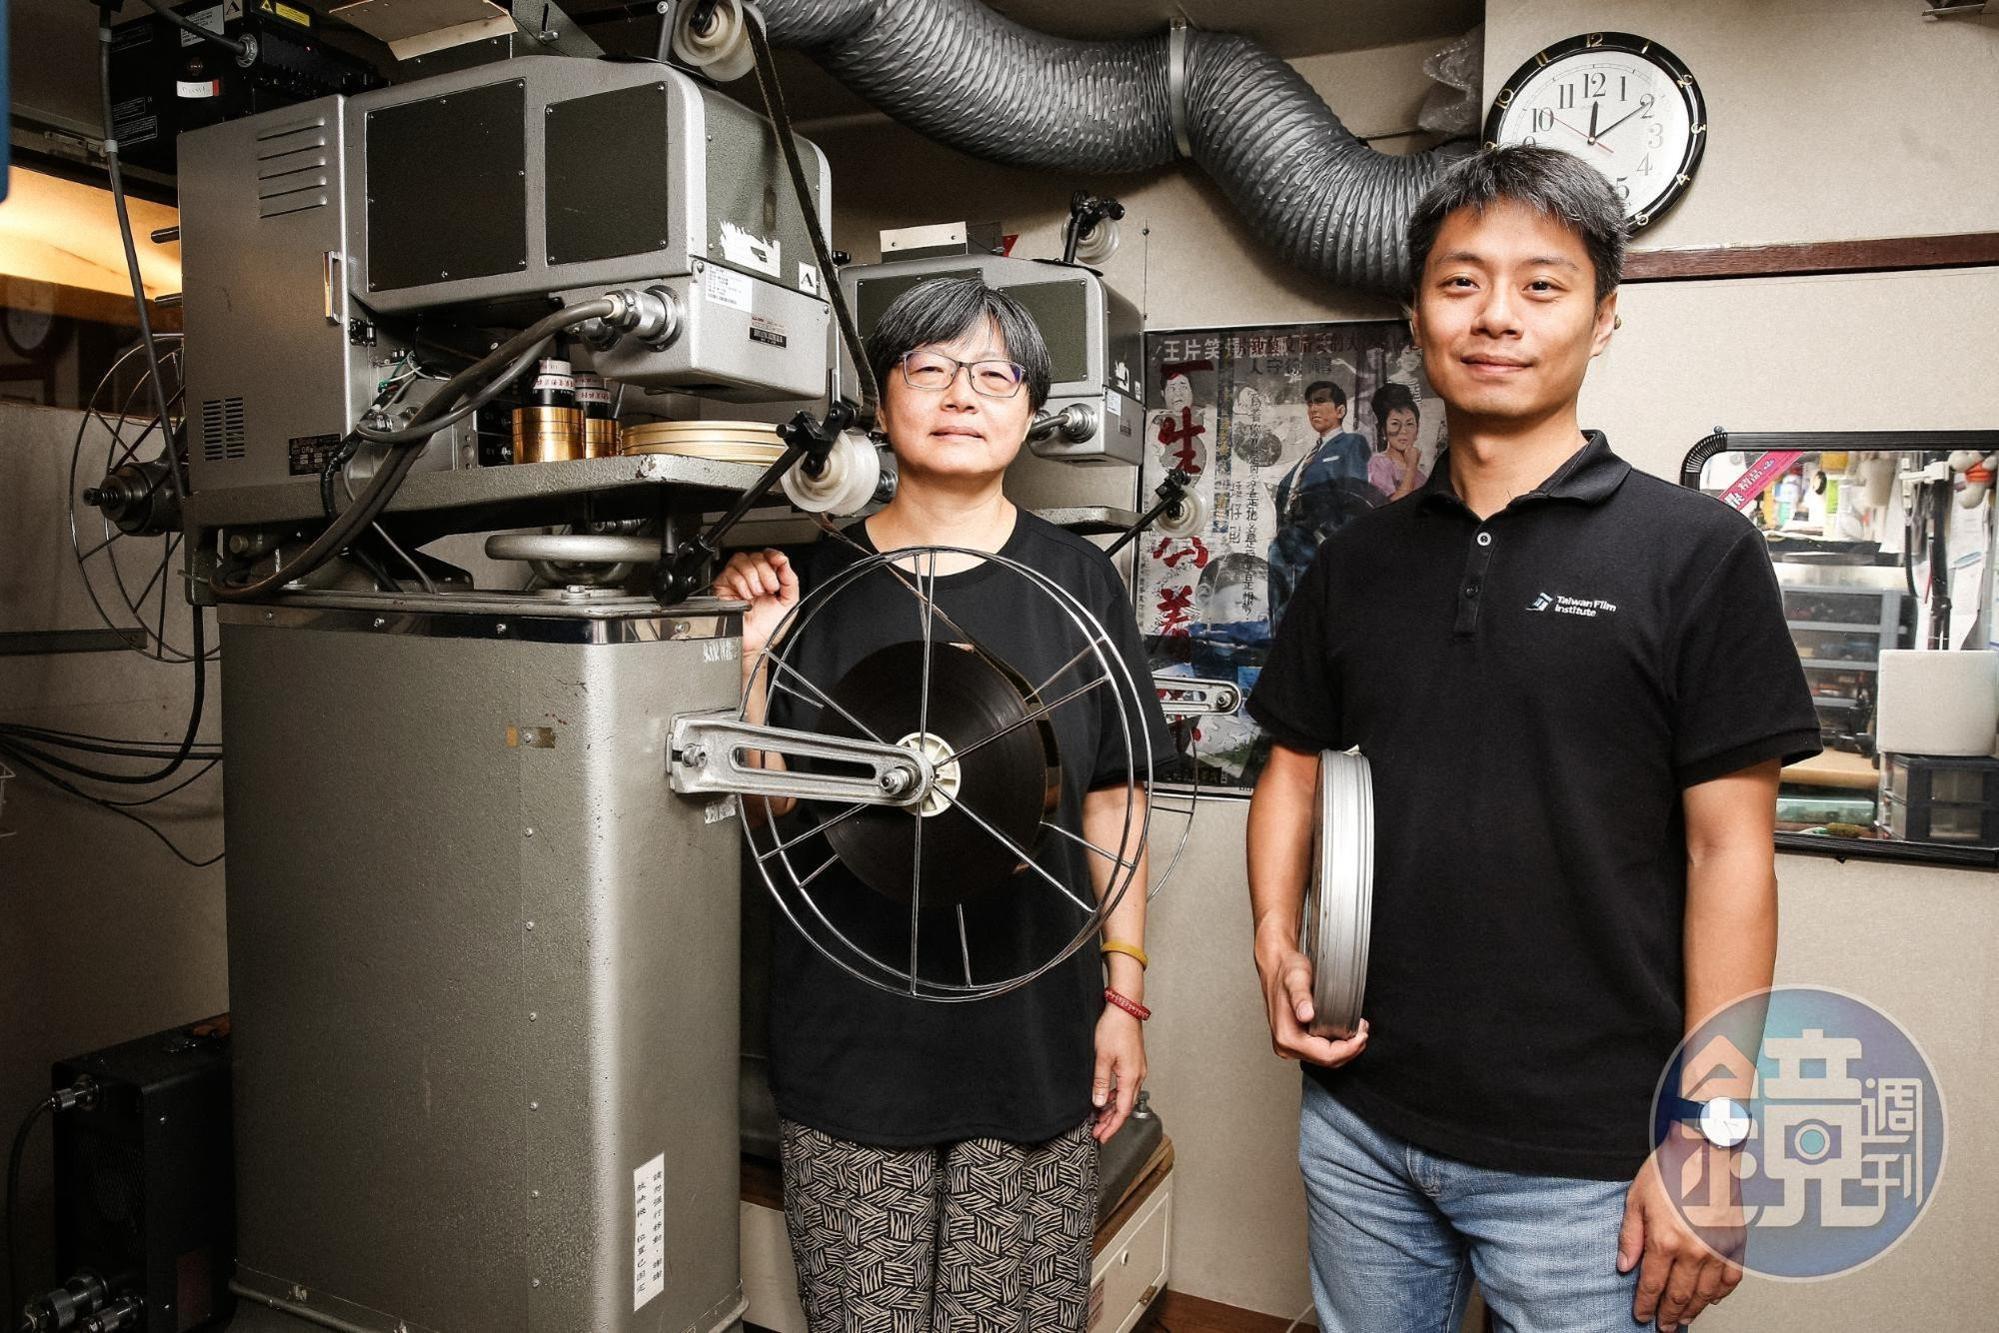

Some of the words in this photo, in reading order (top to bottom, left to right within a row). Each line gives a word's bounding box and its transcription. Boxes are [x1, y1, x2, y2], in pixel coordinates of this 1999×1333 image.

[1558, 83, 1575, 109] 11
[1584, 72, 1606, 98] 12
[1619, 75, 1628, 101] 1
[1639, 93, 1655, 119] 2
[1532, 107, 1554, 132] 10
[1648, 123, 1664, 149] 3
[1636, 153, 1653, 176] 4
[1616, 177, 1630, 201] 5
[1634, 211, 1649, 226] 5
[1554, 604, 1597, 617] Institute
[1557, 595, 1593, 608] Taiwan
[1593, 600, 1617, 612] Film
